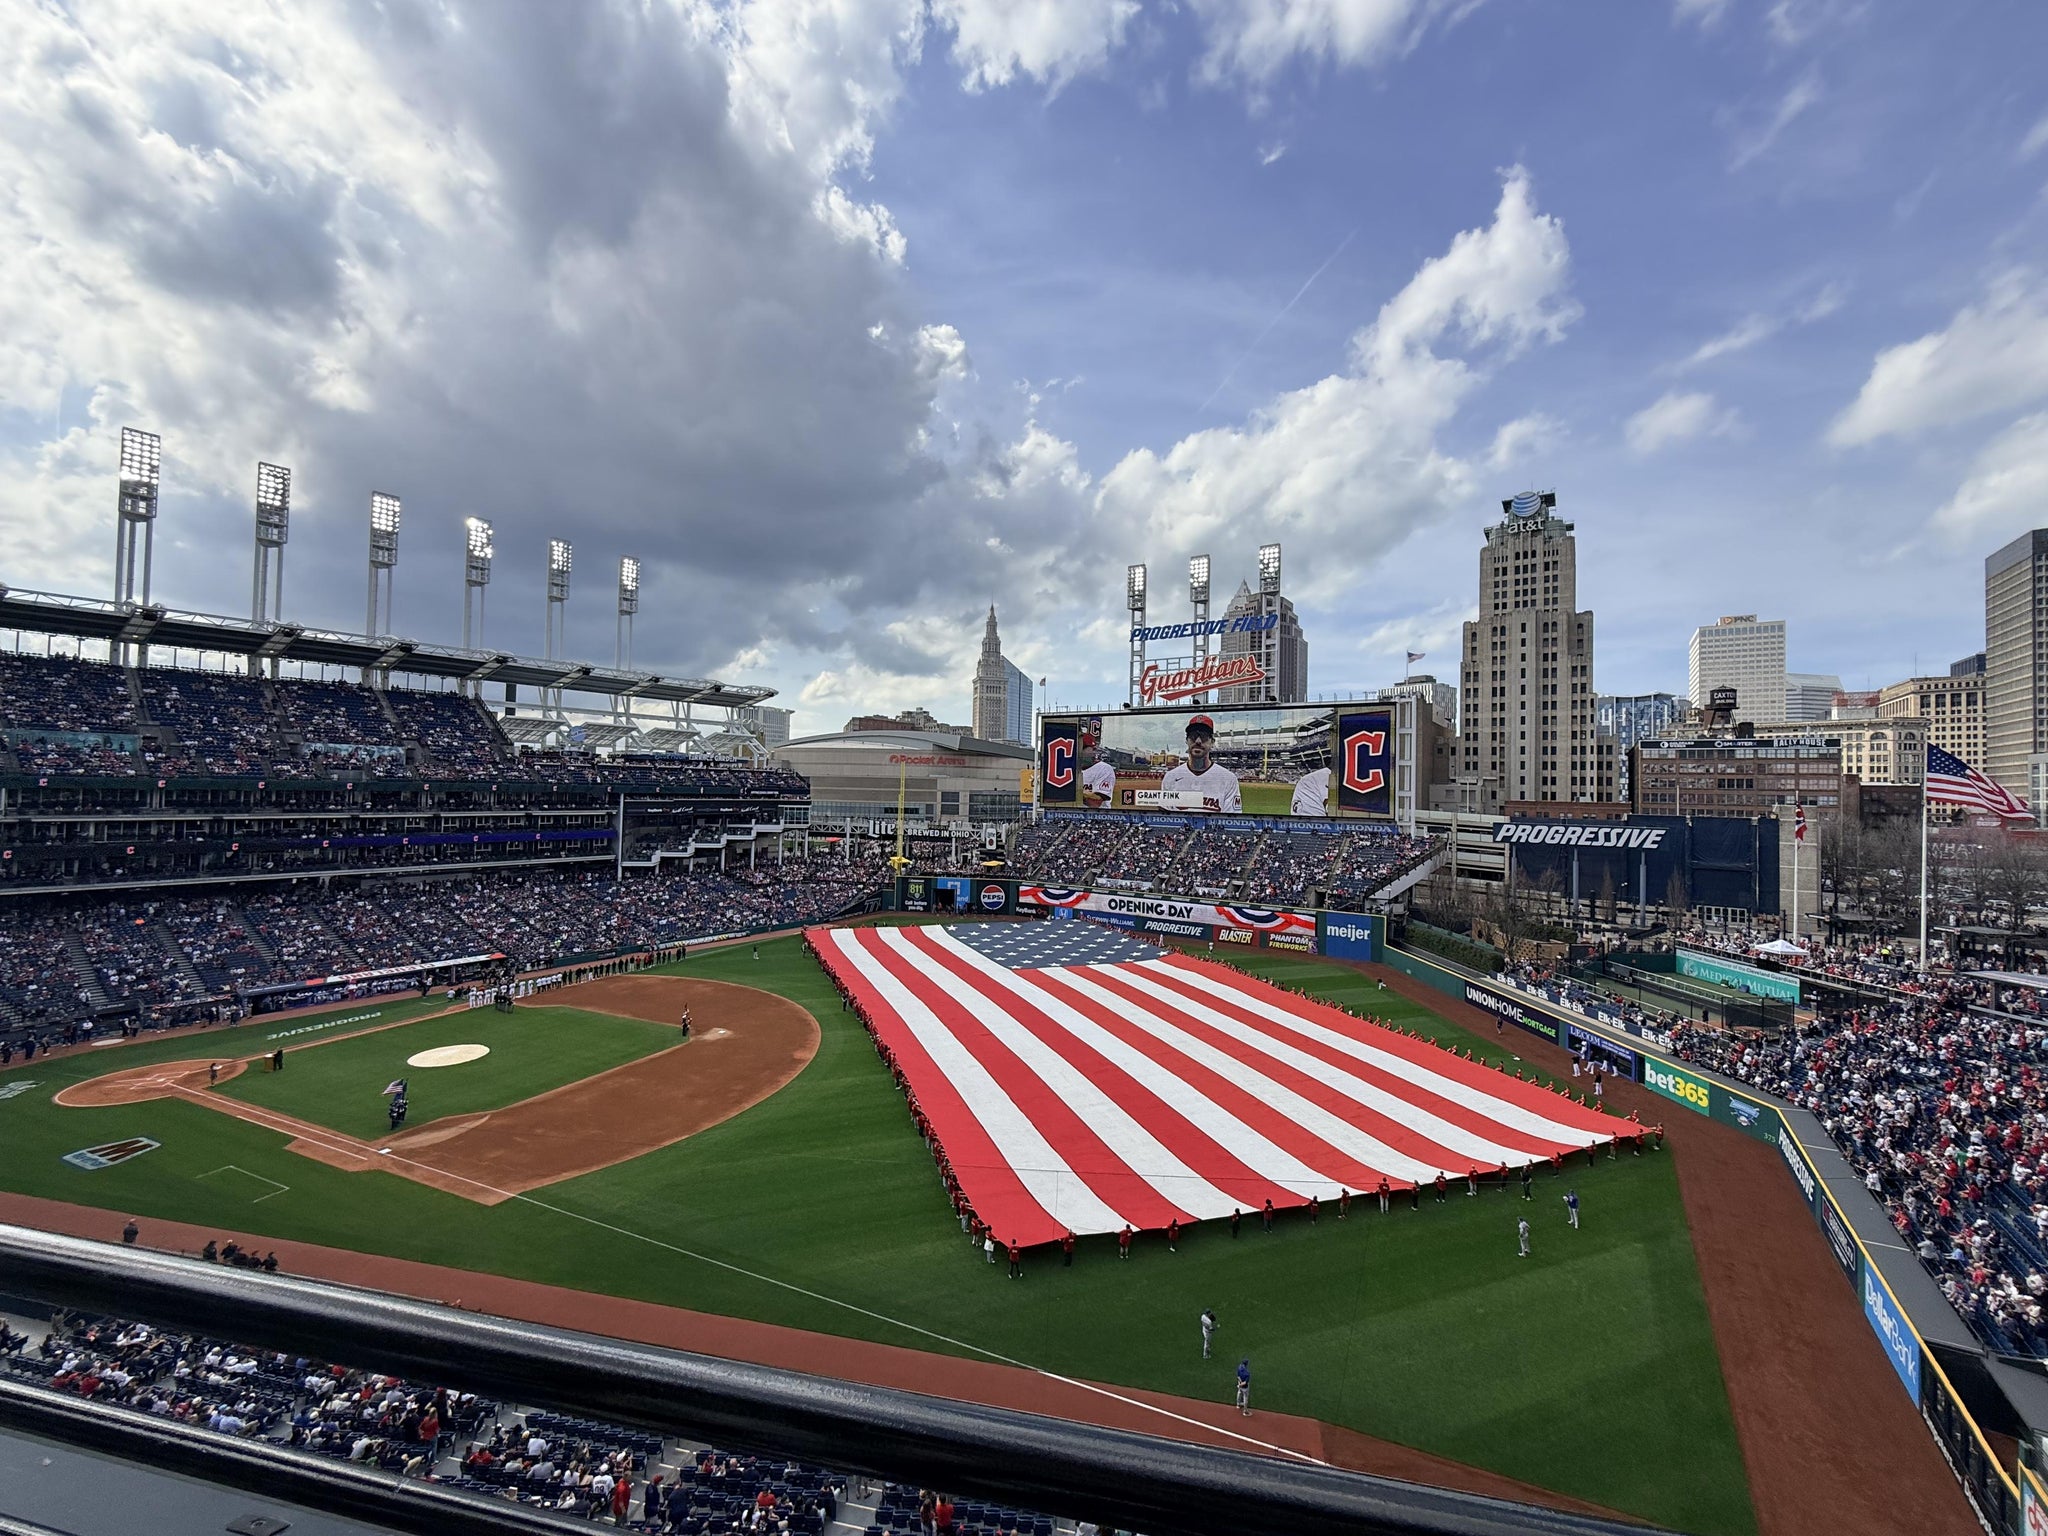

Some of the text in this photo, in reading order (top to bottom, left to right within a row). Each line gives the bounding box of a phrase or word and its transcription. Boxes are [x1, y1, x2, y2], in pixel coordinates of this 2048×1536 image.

[1508, 517, 1544, 534] at&t
[1733, 615, 1755, 623] PNC
[1130, 614, 1278, 642] PROGRESSIVE FIELD
[1139, 654, 1266, 703] Guardians
[1773, 738, 1827, 748] RALLY HOUSE
[900, 755, 966, 765] Rocket Arena
[1046, 737, 1074, 788] C
[1343, 730, 1386, 794] C
[1162, 792, 1179, 800] FINK
[1152, 816, 1188, 824] HONDA
[1217, 819, 1257, 827] HONDA
[1288, 822, 1332, 830] HONDA
[868, 820, 896, 838] Lite
[907, 828, 969, 838] BREWED IN OHIO
[1345, 824, 1392, 833] HONDA
[1495, 824, 1667, 849] PROGRESSIVE
[909, 885, 923, 894] 811
[1015, 906, 1036, 914] KeyBank
[1108, 899, 1193, 919] OPENING DAY
[1145, 920, 1203, 936] PROGRESSIVE
[1327, 924, 1370, 942] meijer
[1218, 929, 1252, 944] BLASTER
[1269, 933, 1309, 945] PHANTOM
[1268, 941, 1308, 952] FIREWORKS
[266, 1012, 381, 1040] PROGRESSIVE
[1522, 1016, 1556, 1037] MORTGAGE
[1570, 1026, 1601, 1047] LECOM
[1645, 1062, 1708, 1108] bet365
[1763, 1133, 1776, 1143] 375
[1778, 1127, 1815, 1202] PROGRESSIVE
